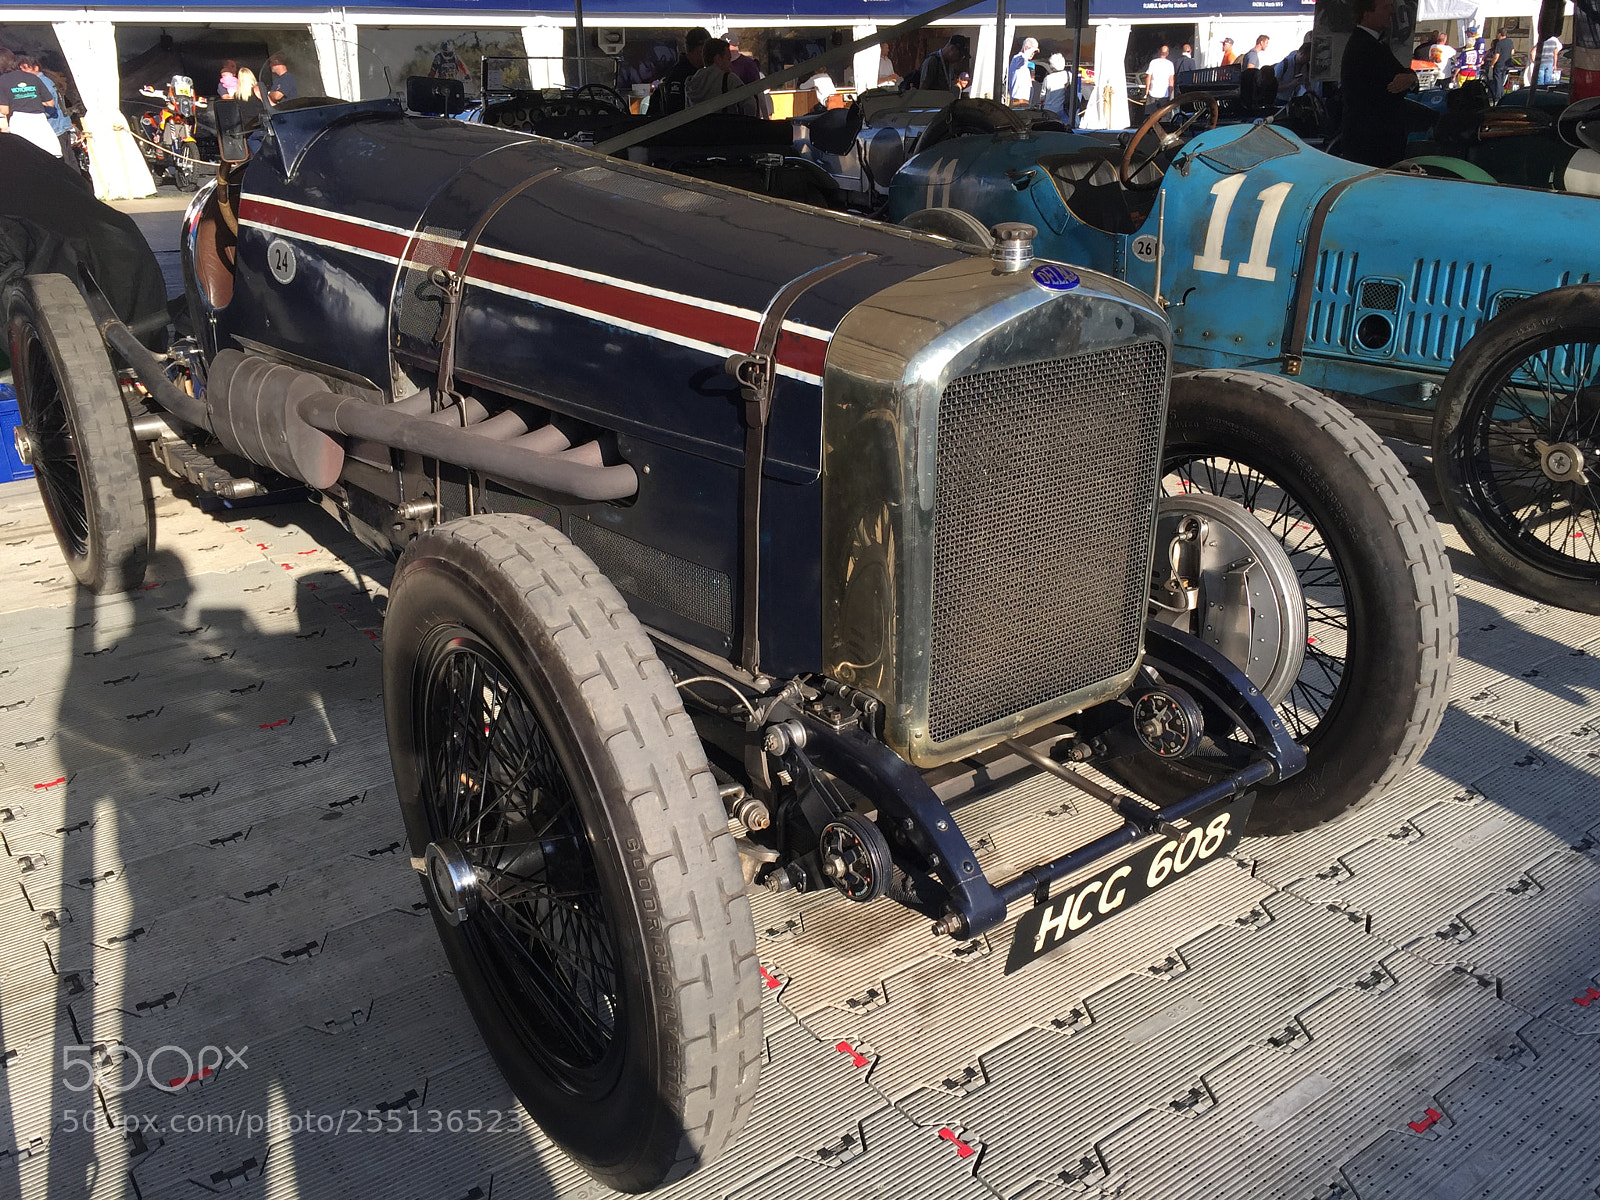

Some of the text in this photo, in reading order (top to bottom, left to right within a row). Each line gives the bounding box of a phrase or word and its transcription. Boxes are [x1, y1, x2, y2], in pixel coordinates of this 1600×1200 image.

[275, 248, 288, 273] 24
[1192, 173, 1294, 282] 11
[1146, 812, 1231, 888] 608
[624, 838, 670, 976] GOODRICH
